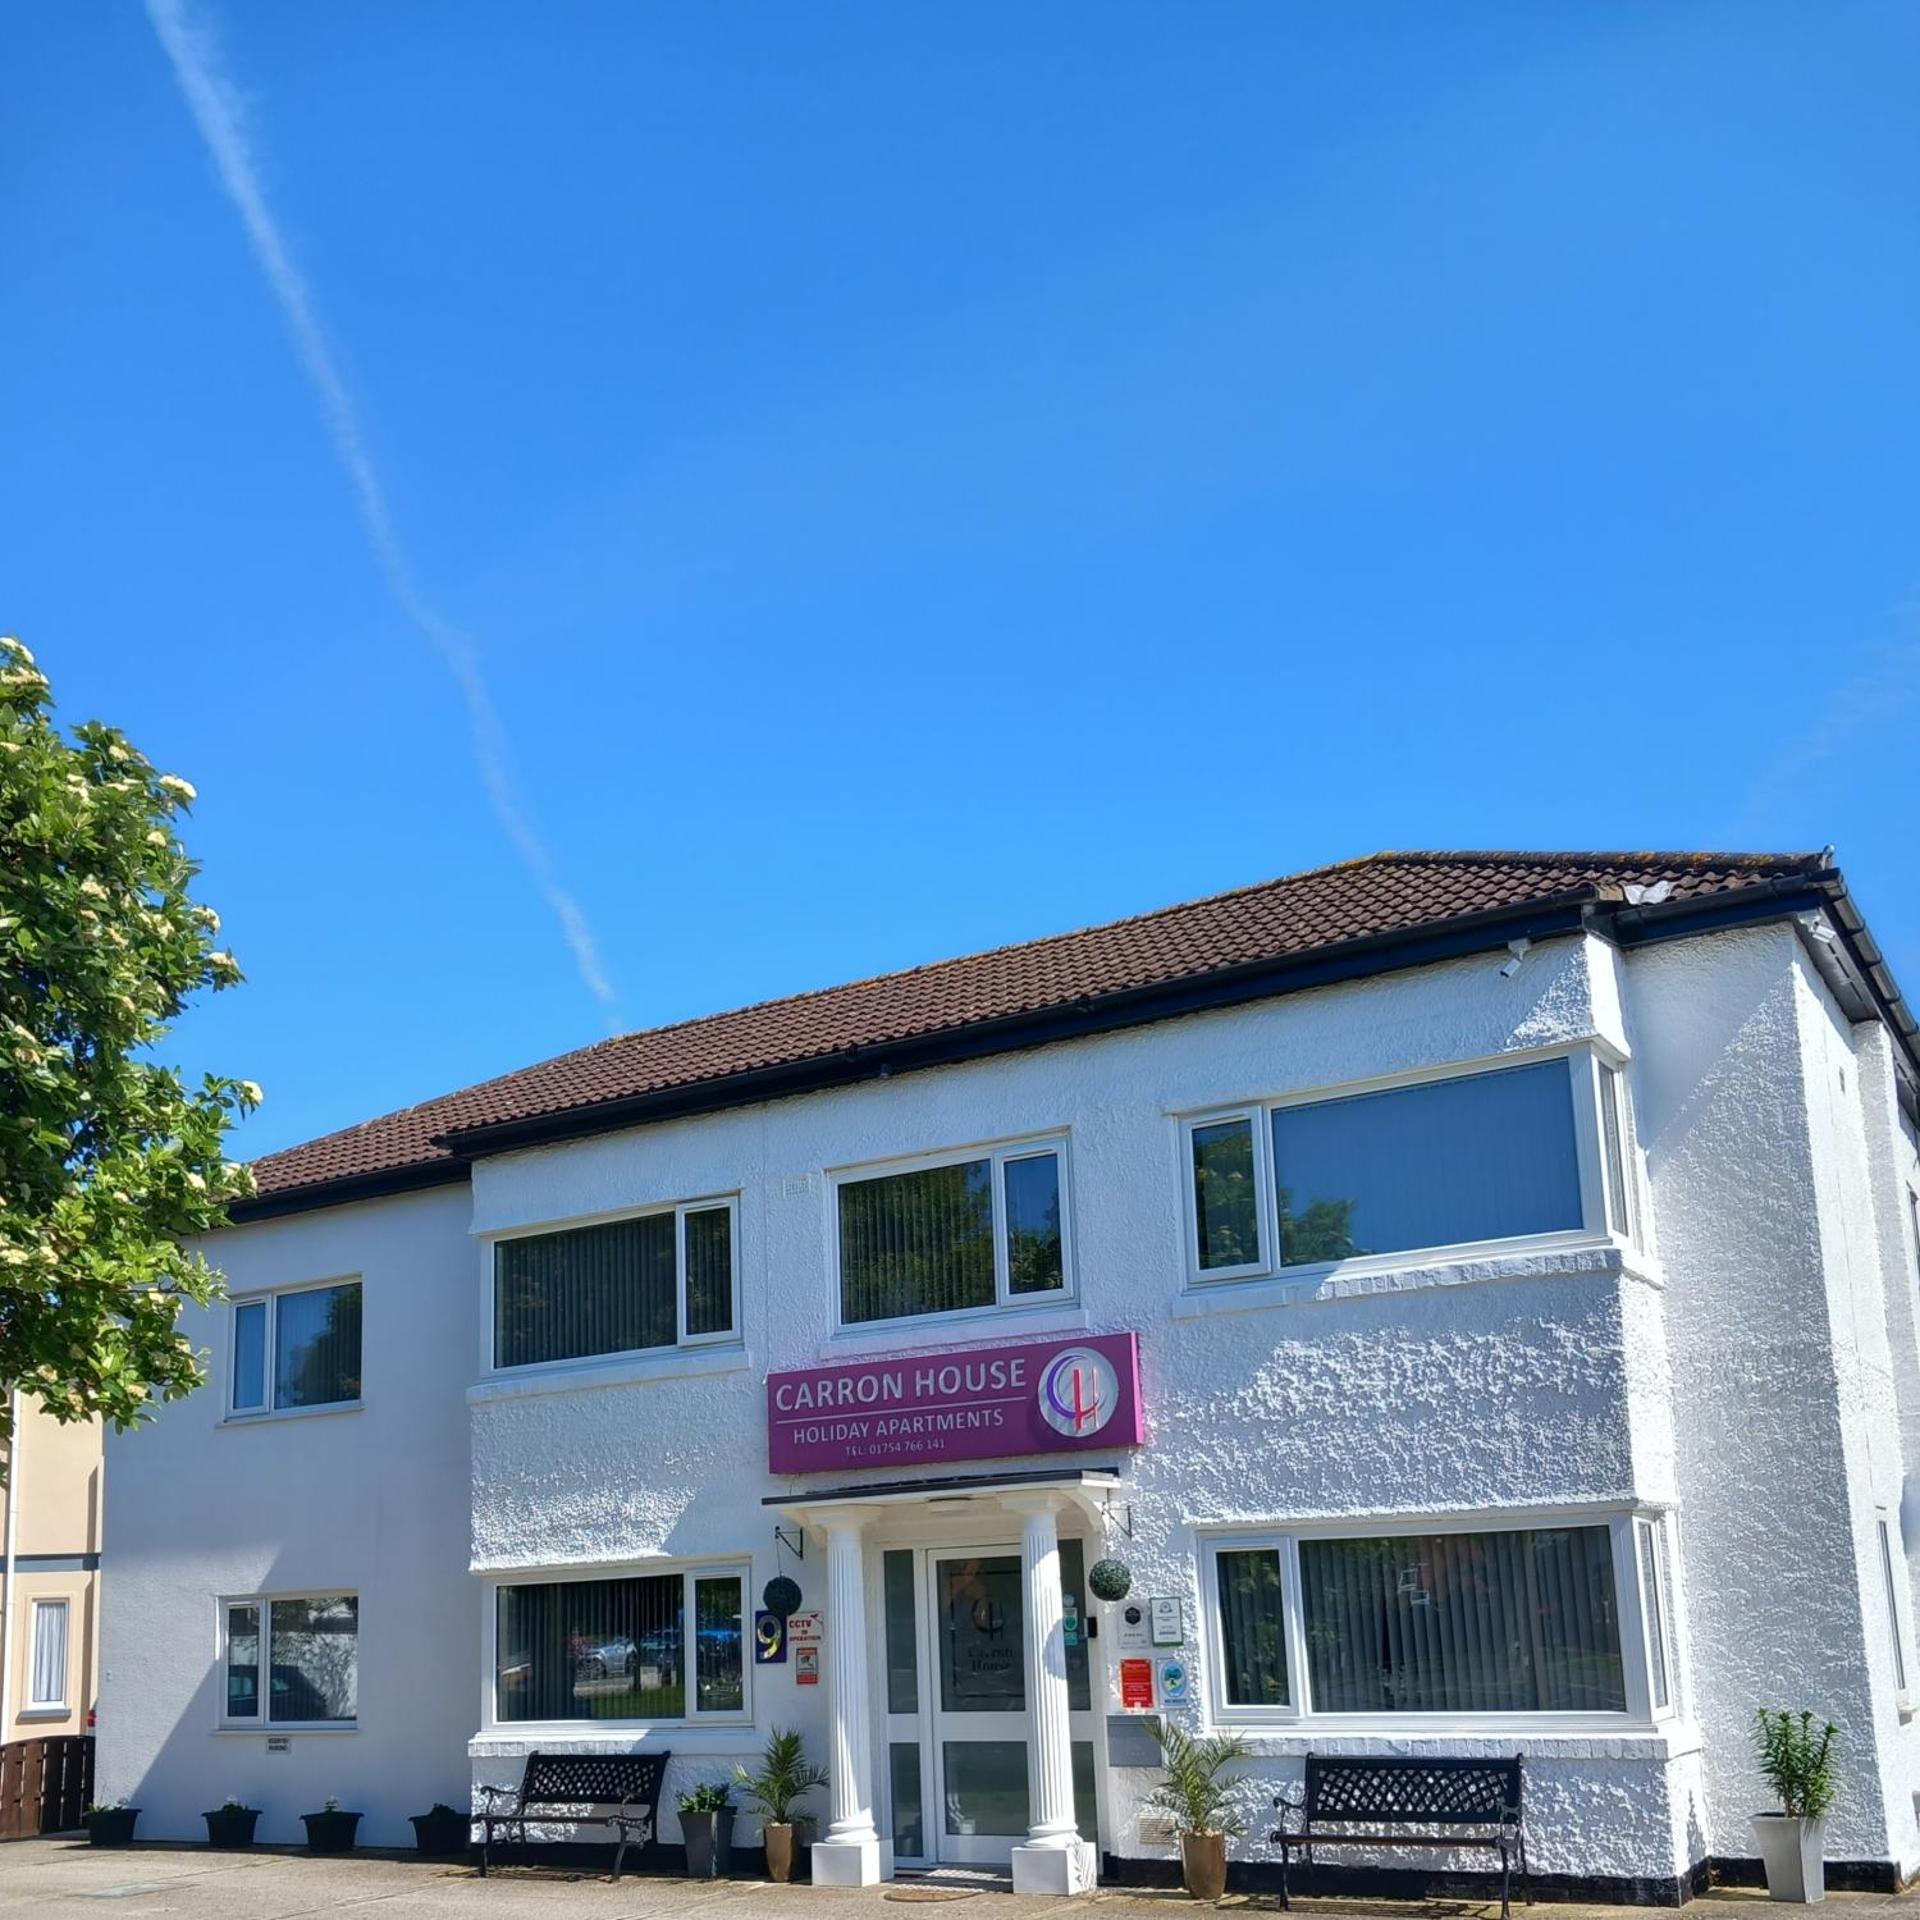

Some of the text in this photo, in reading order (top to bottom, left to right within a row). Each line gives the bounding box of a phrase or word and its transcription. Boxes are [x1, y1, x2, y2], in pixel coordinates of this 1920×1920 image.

[776, 1358, 1026, 1411] CARRON HOUSE
[793, 1408, 1004, 1444] HOLIDAY APARTMENTS
[869, 1442, 901, 1455] 01754
[905, 1440, 924, 1451] 766
[927, 1437, 945, 1450] 141
[757, 1615, 782, 1660] 9
[789, 1620, 811, 1628] CCTV
